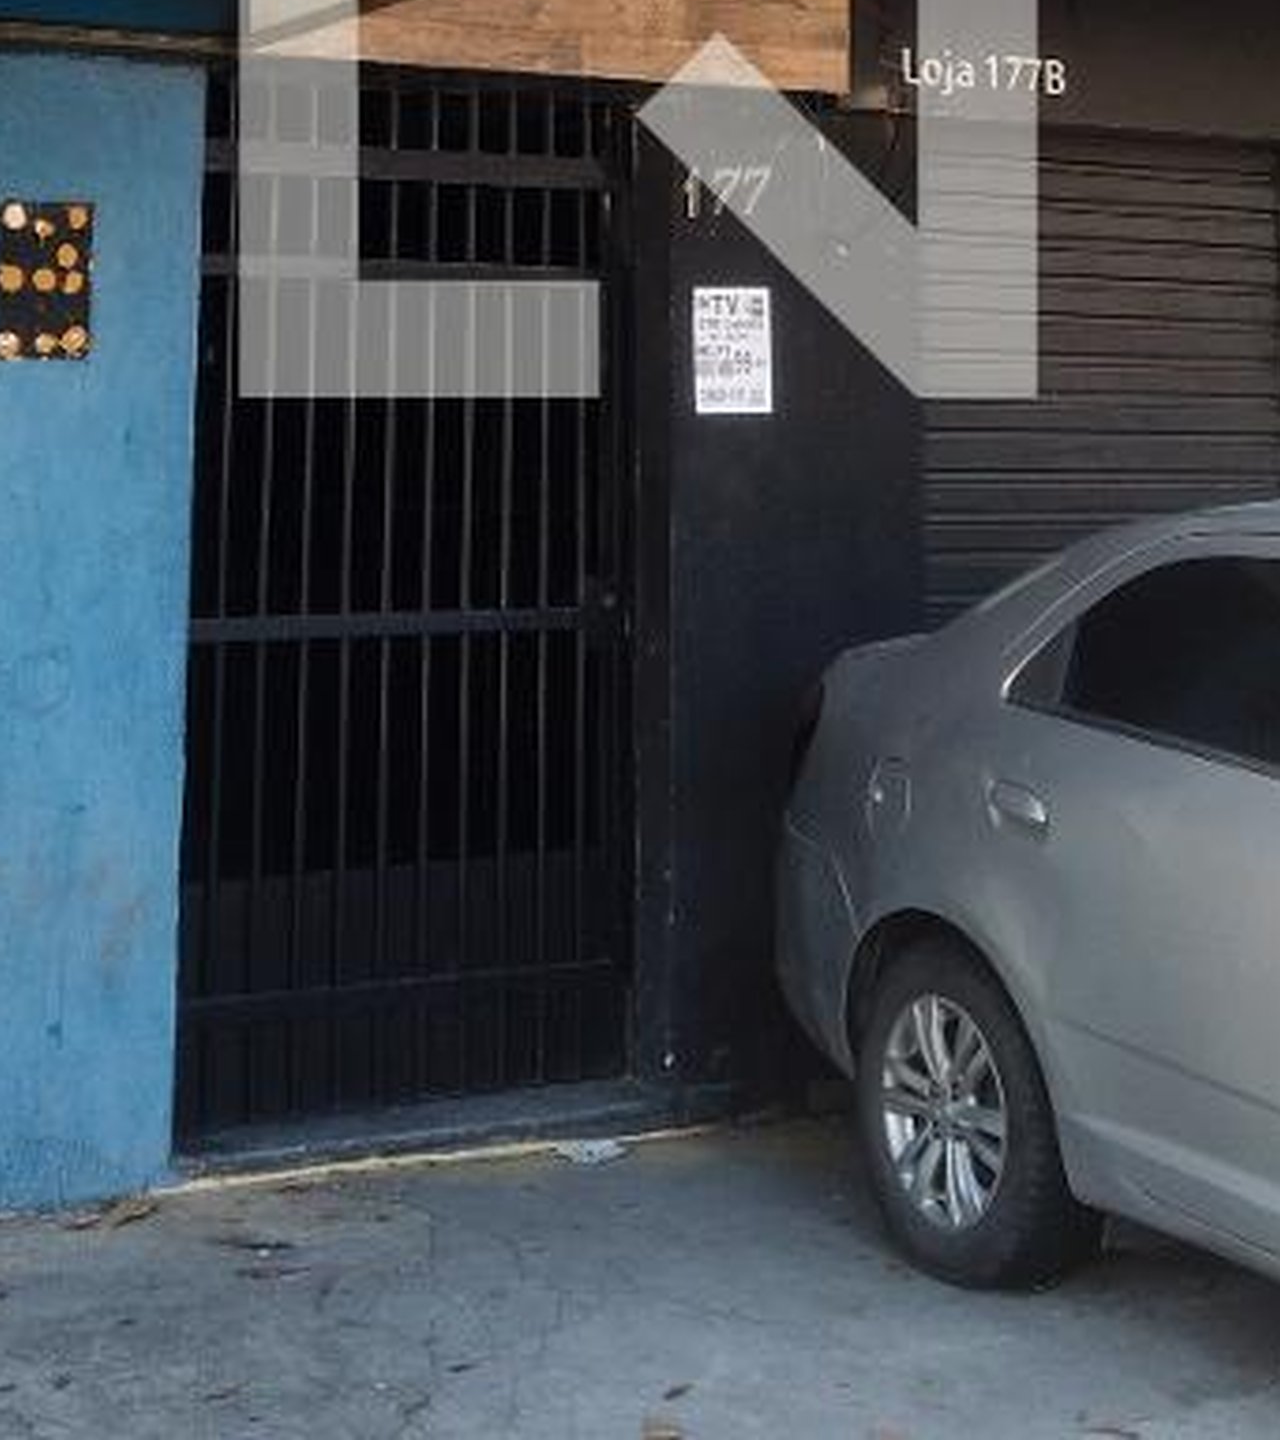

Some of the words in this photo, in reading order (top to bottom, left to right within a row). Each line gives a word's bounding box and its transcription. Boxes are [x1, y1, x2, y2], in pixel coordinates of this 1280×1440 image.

[902, 47, 975, 101] Loja
[986, 55, 1066, 96] 177B
[683, 165, 772, 219] 177
